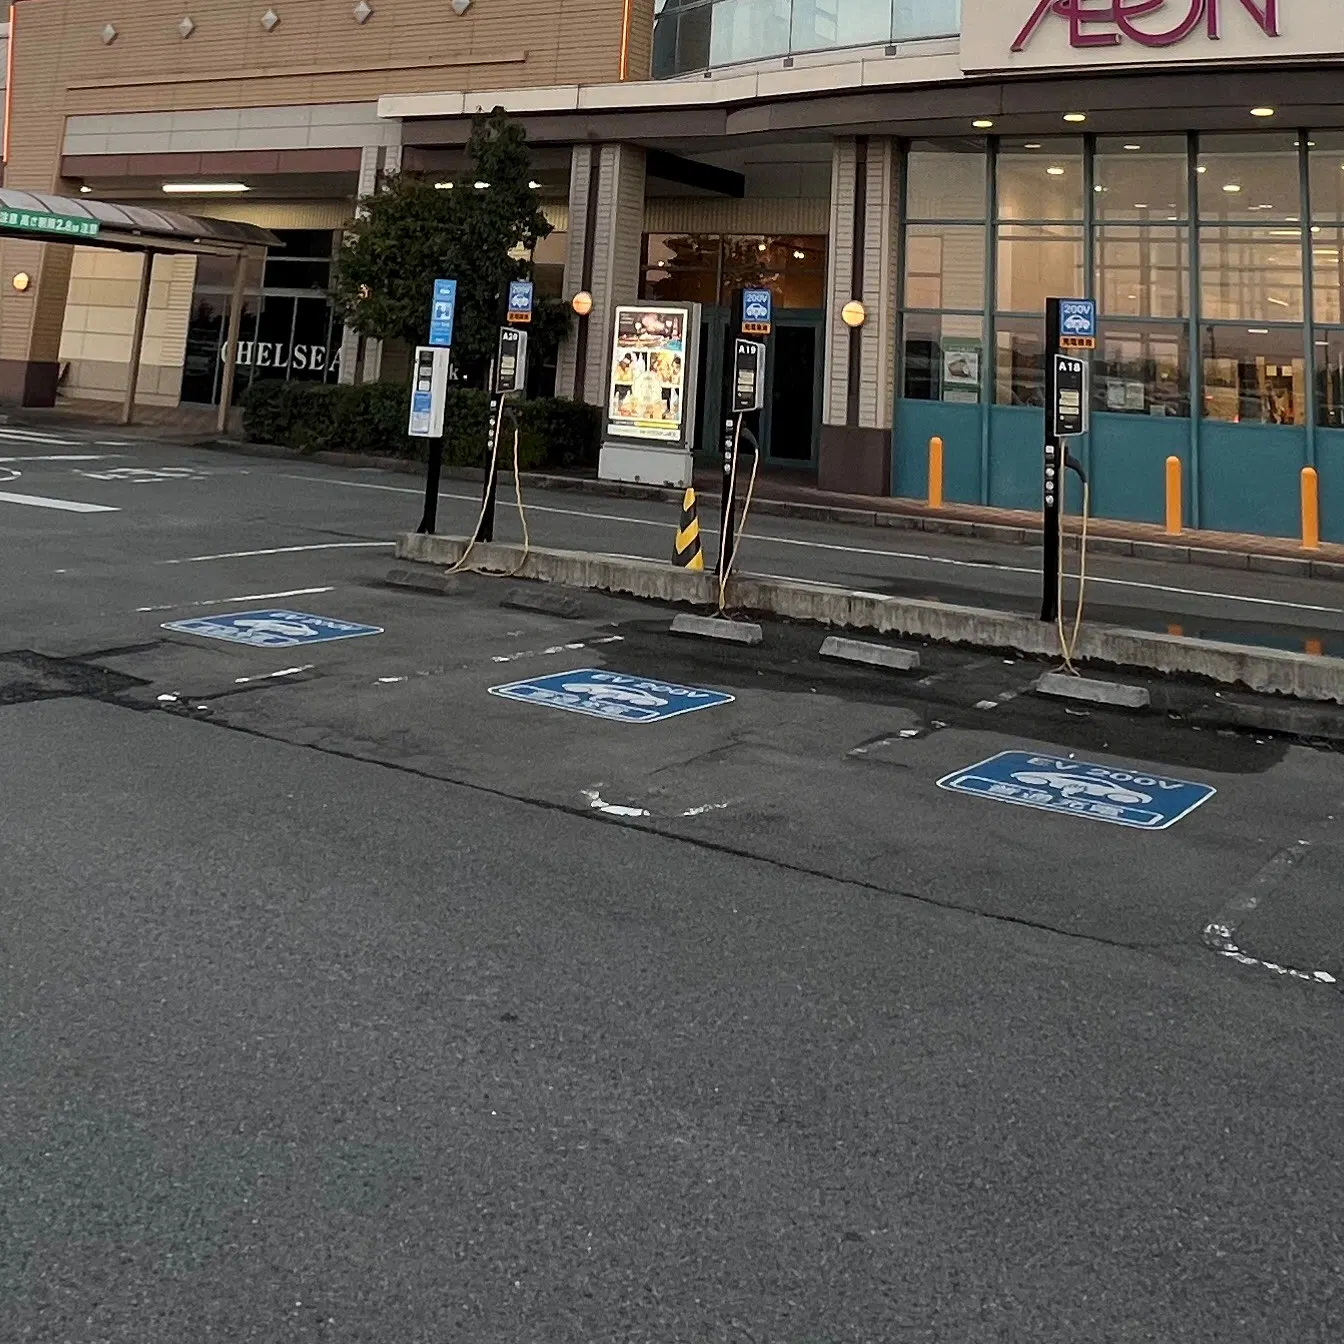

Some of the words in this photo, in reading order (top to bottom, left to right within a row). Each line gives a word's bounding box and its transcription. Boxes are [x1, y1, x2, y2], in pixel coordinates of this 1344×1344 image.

[1064, 304, 1091, 315] 200V
[738, 344, 757, 355] A19
[1058, 361, 1081, 373] A18
[1027, 757, 1079, 771] EV
[1086, 768, 1185, 791] 200V
